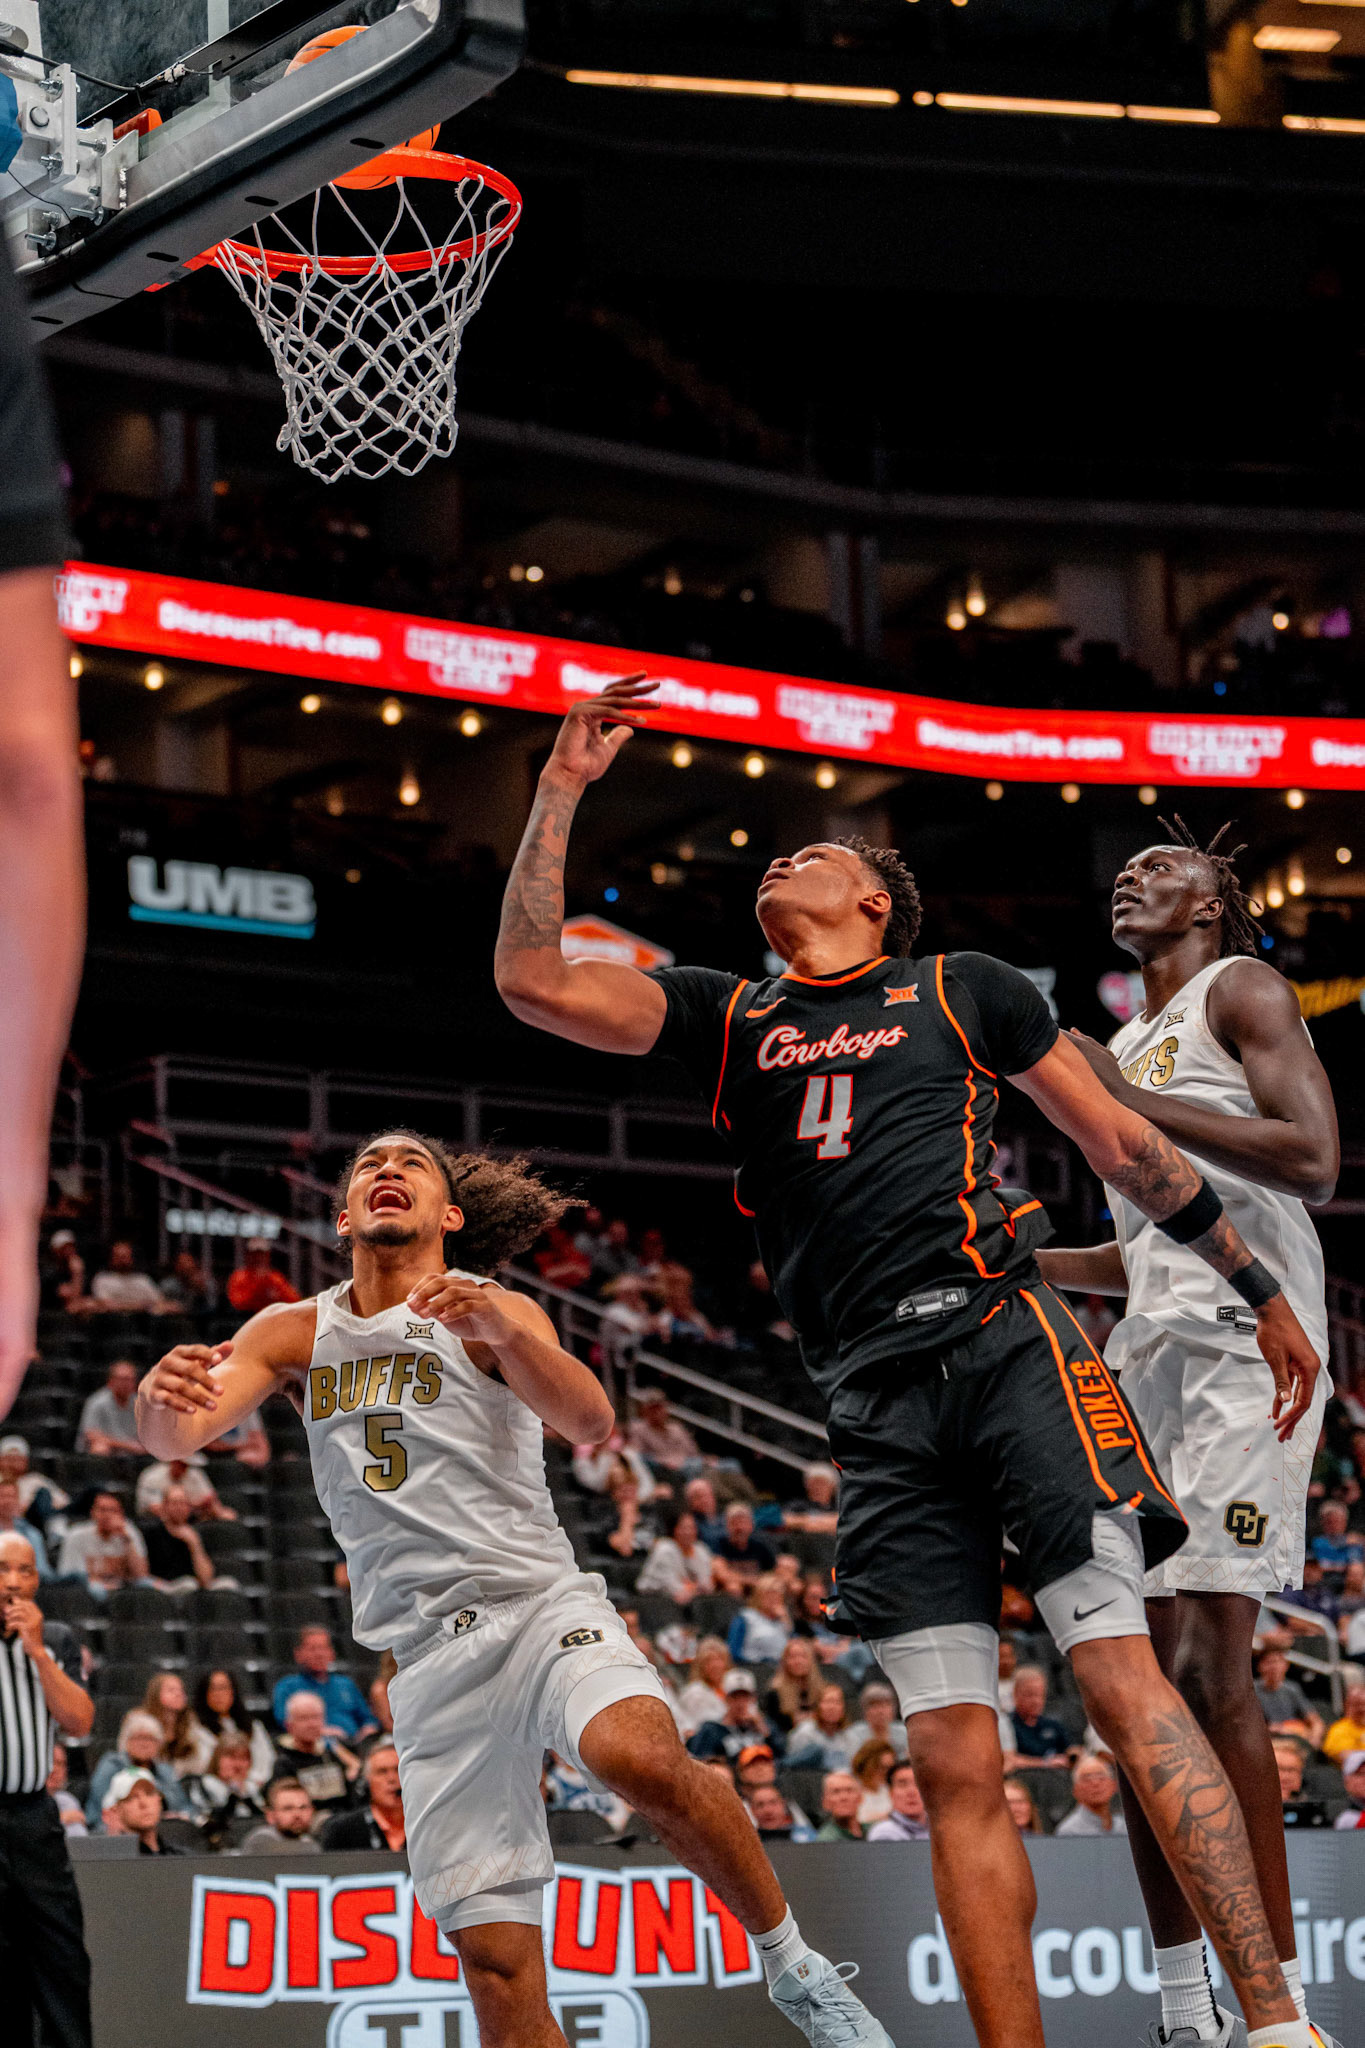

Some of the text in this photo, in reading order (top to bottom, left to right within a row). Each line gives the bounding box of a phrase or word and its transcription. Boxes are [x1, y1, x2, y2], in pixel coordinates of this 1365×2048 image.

[128, 854, 317, 925] UMB
[757, 1023, 908, 1071] Cowboys
[797, 1074, 854, 1160] 4
[310, 1353, 443, 1421] BUFFS
[1069, 1360, 1134, 1450] POKES
[363, 1414, 408, 1492] 5
[192, 1868, 757, 2001] DISCUNT
[367, 2003, 604, 2048] TIE
